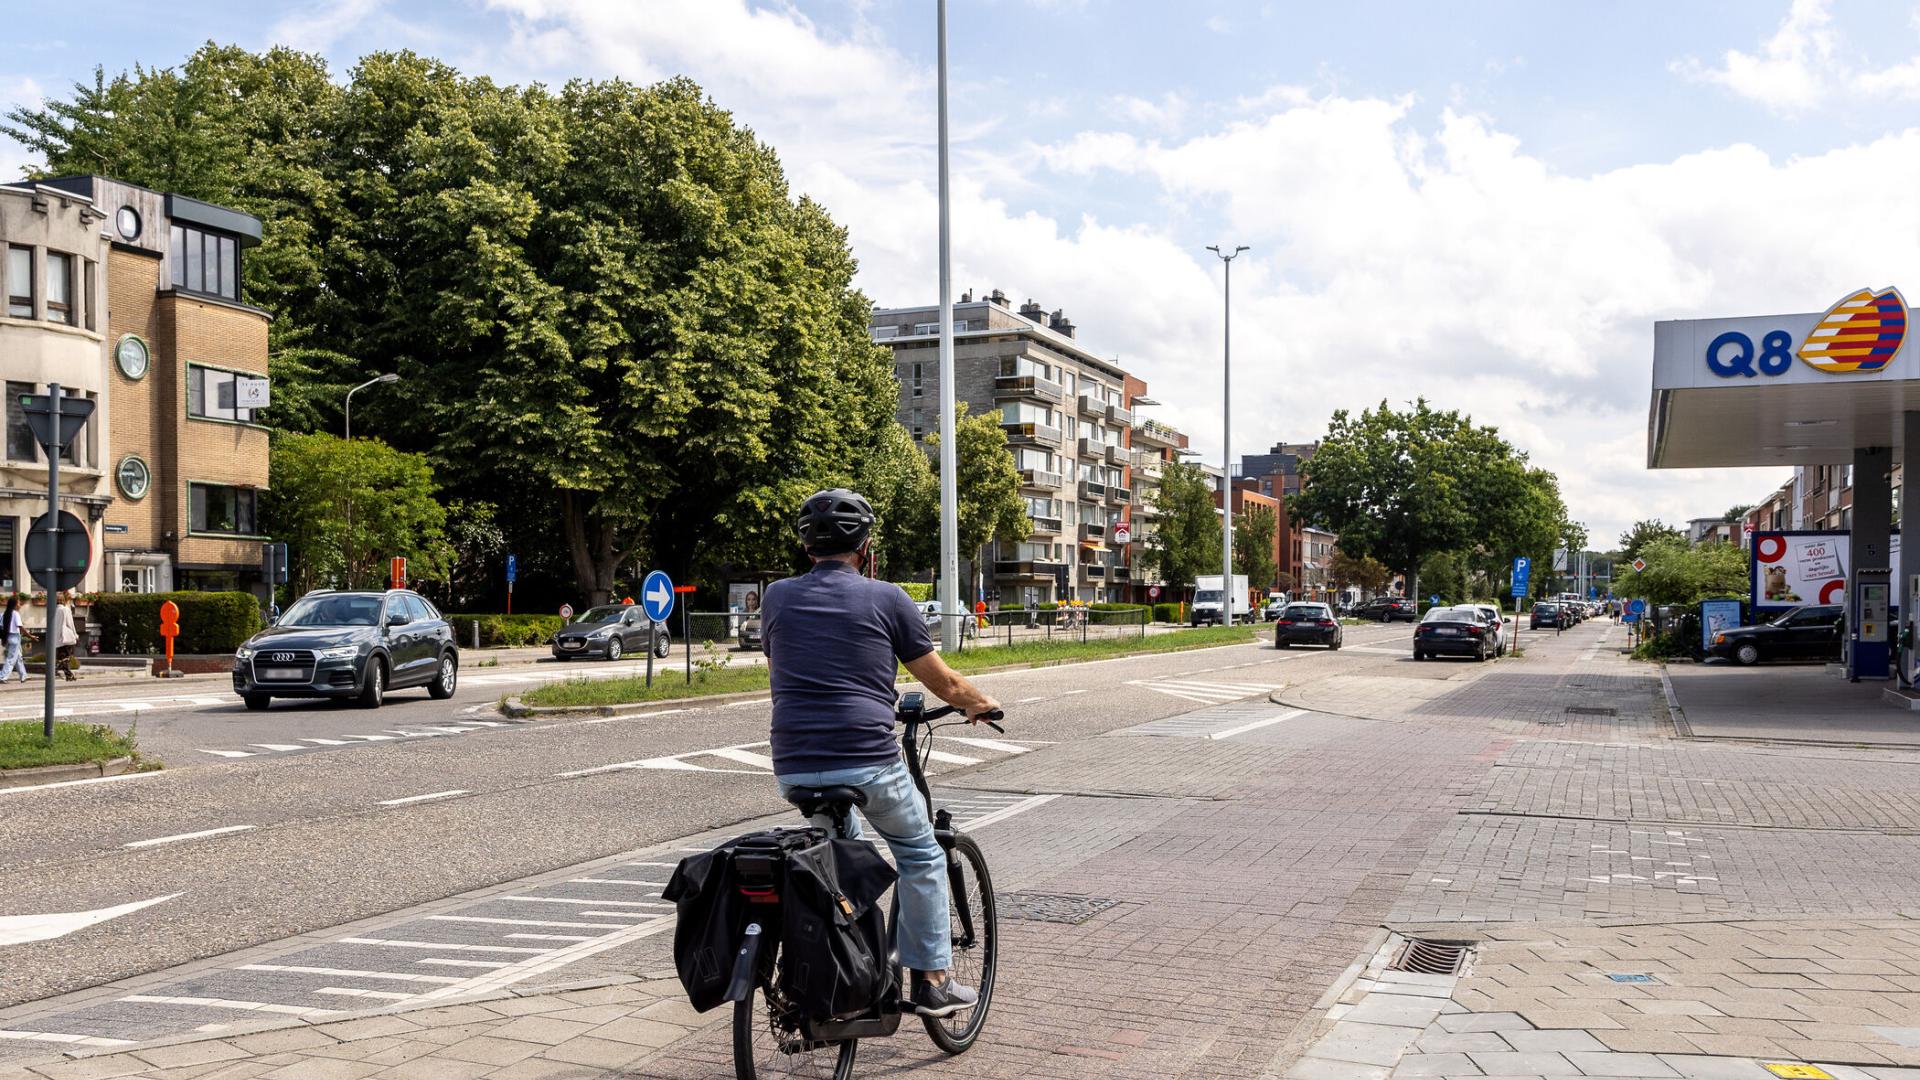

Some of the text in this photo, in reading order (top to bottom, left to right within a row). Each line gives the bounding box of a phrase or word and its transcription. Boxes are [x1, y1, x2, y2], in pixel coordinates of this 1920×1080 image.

[1706, 330, 1793, 378] Q8
[1806, 547, 1826, 557] 400
[509, 555, 515, 566] P
[1516, 559, 1527, 573] P
